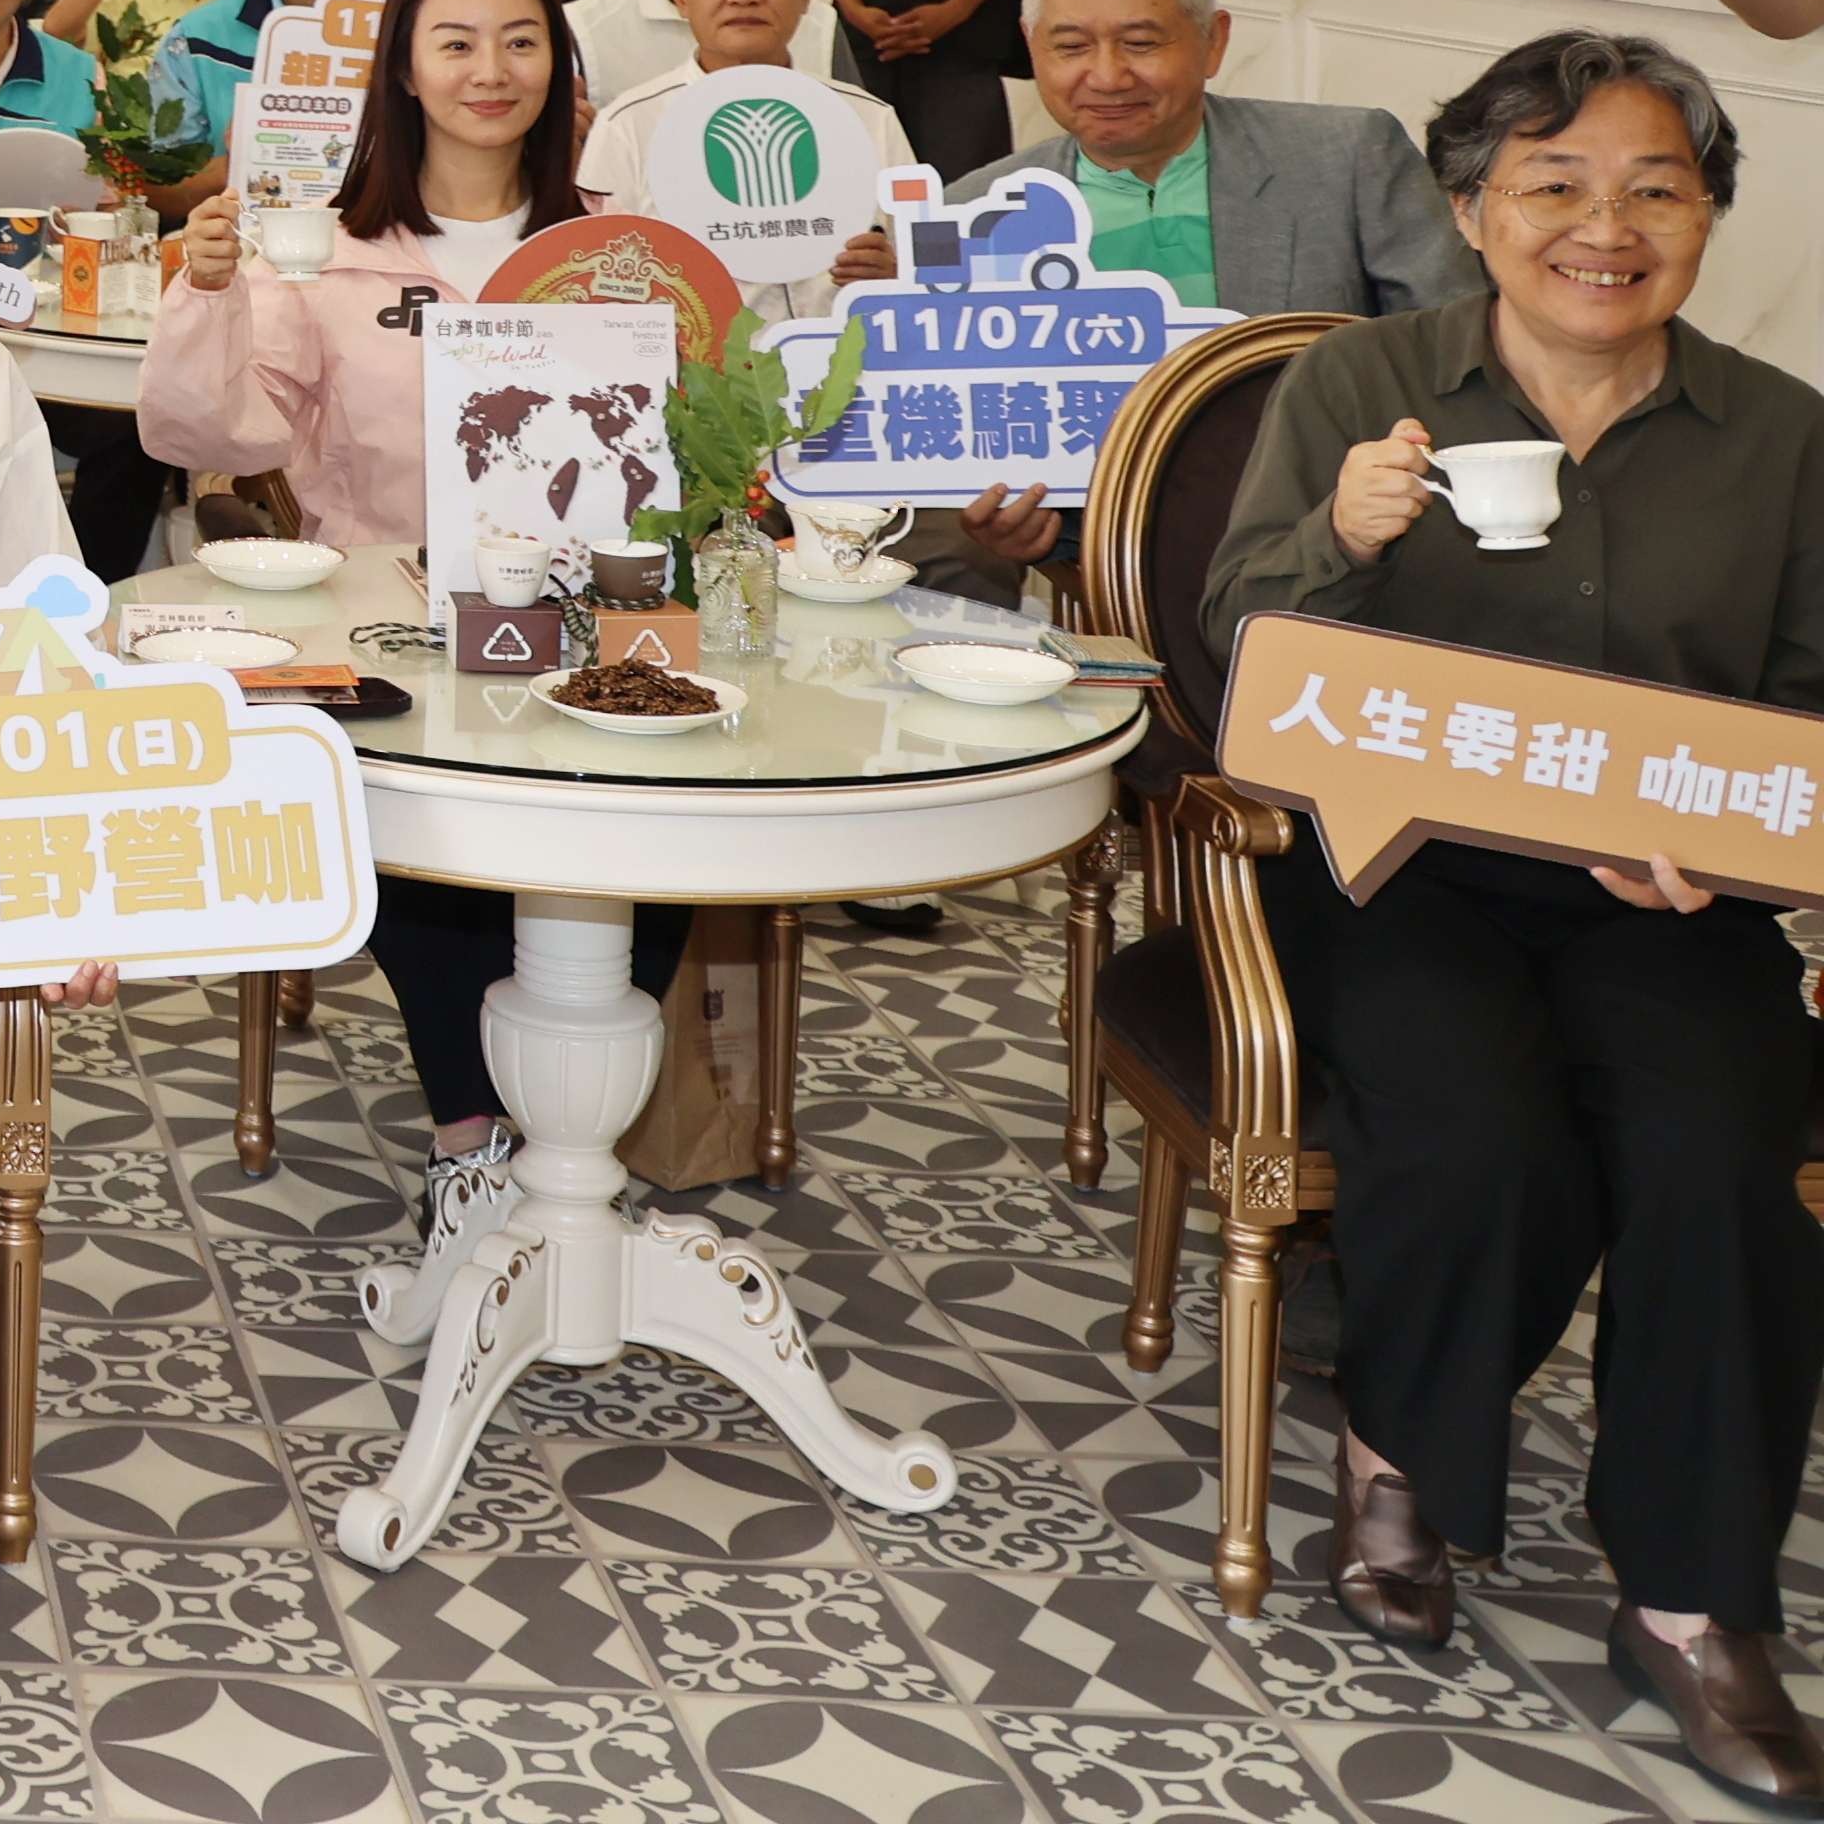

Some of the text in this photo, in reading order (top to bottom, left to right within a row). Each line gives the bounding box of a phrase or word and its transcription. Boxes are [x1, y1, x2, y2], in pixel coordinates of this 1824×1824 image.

[705, 217, 835, 241] 古坑鄉農會
[435, 318, 534, 339] 台灣咖啡節
[871, 304, 1146, 356] 11/07(六)
[1269, 673, 1824, 837] 人生要甜 咖啡
